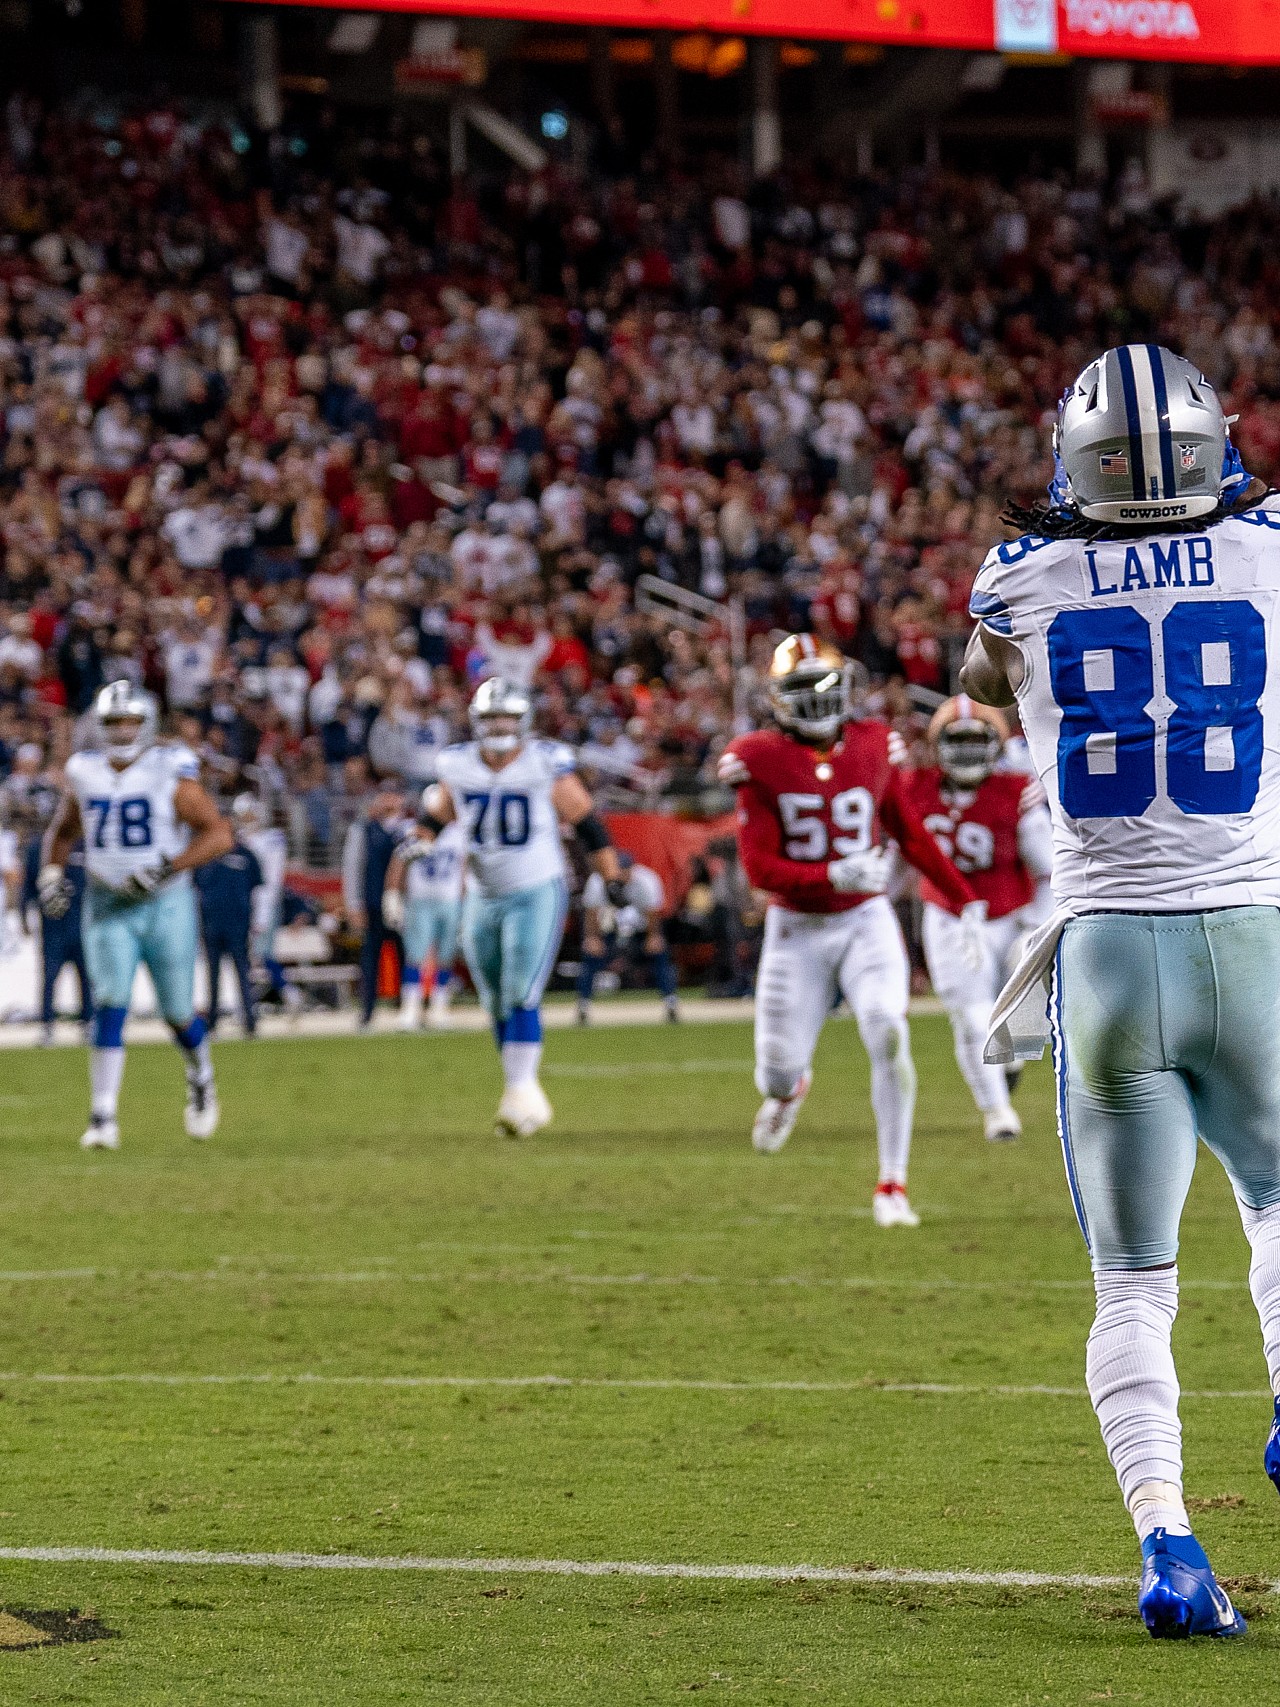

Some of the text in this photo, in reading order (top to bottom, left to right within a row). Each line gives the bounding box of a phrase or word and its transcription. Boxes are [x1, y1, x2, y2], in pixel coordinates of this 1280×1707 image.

[1061, 0, 1200, 40] TOYOTA
[1119, 504, 1187, 519] COWBOYS
[1084, 536, 1216, 598] LAMB
[1046, 600, 1267, 819] 88
[85, 797, 153, 849] 78
[463, 792, 531, 847] 70
[777, 786, 875, 861] 59
